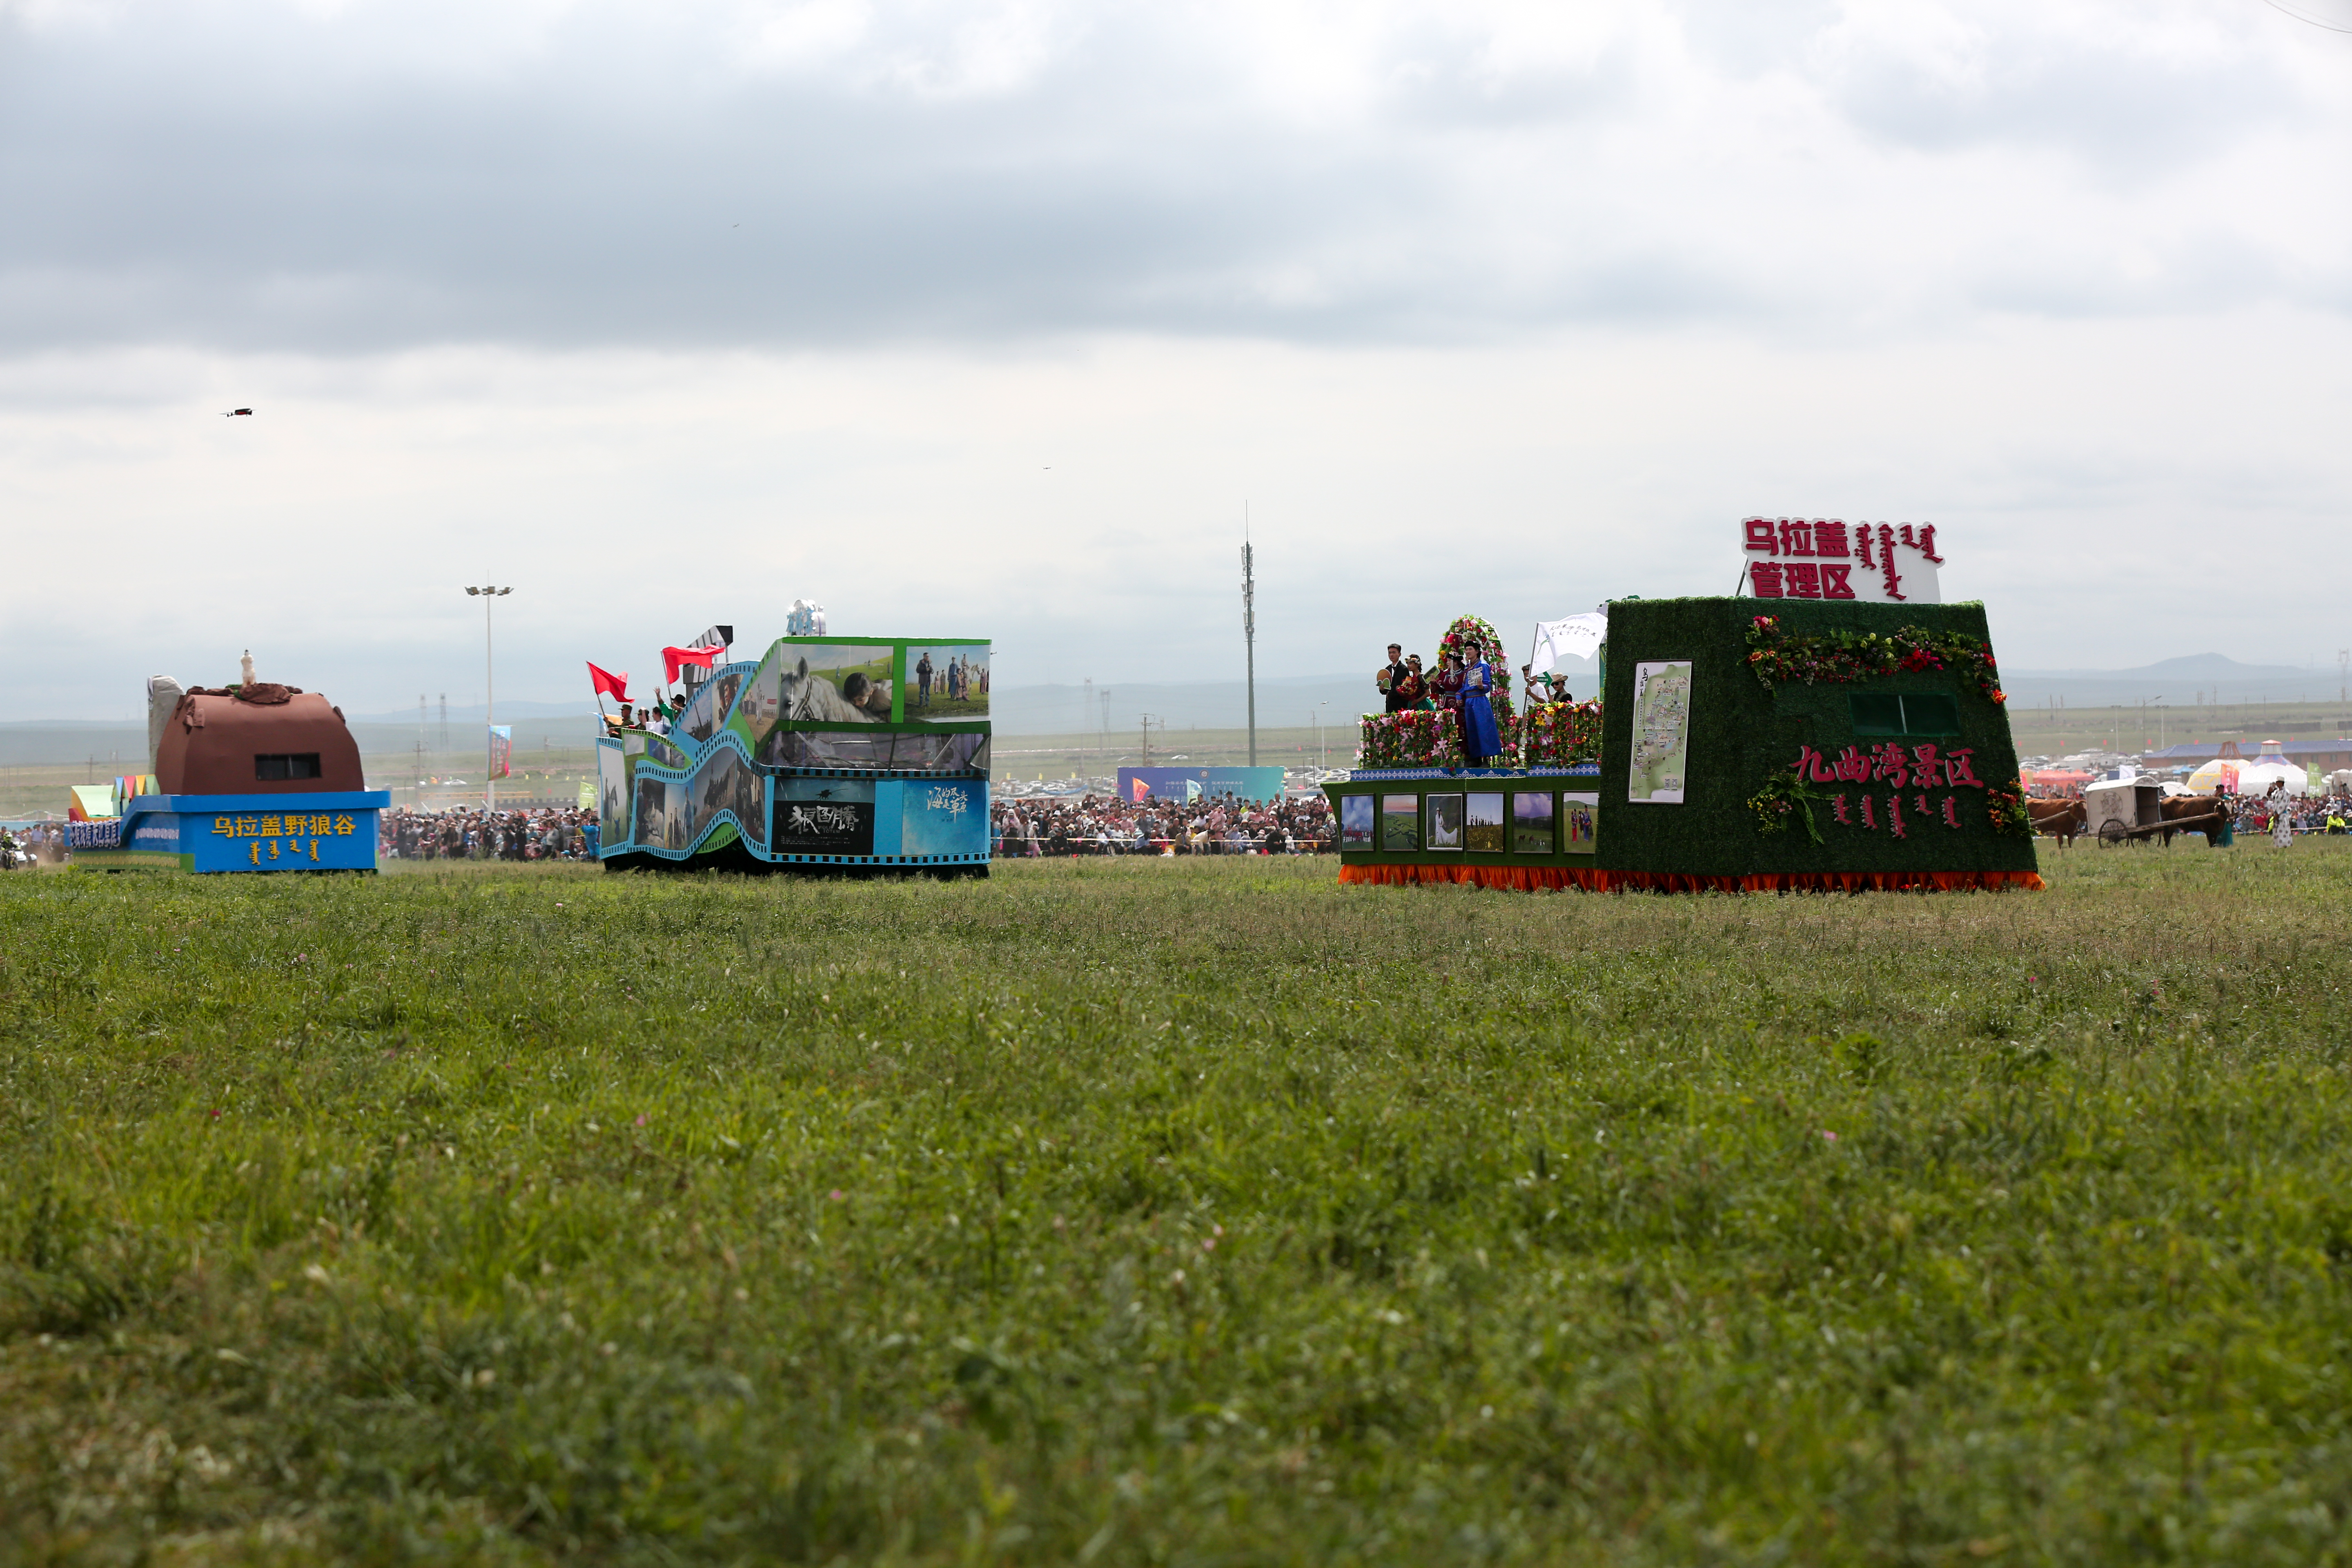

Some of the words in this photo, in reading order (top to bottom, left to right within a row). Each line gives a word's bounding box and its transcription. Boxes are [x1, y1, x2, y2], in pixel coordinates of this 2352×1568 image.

[1746, 520, 1850, 557] 乌拉盖
[1750, 561, 1855, 599] 管理区
[1788, 742, 1984, 789] 九曲湾景区
[212, 815, 356, 838] 乌拉盖野狼谷
[788, 805, 859, 834] 狼图腾
